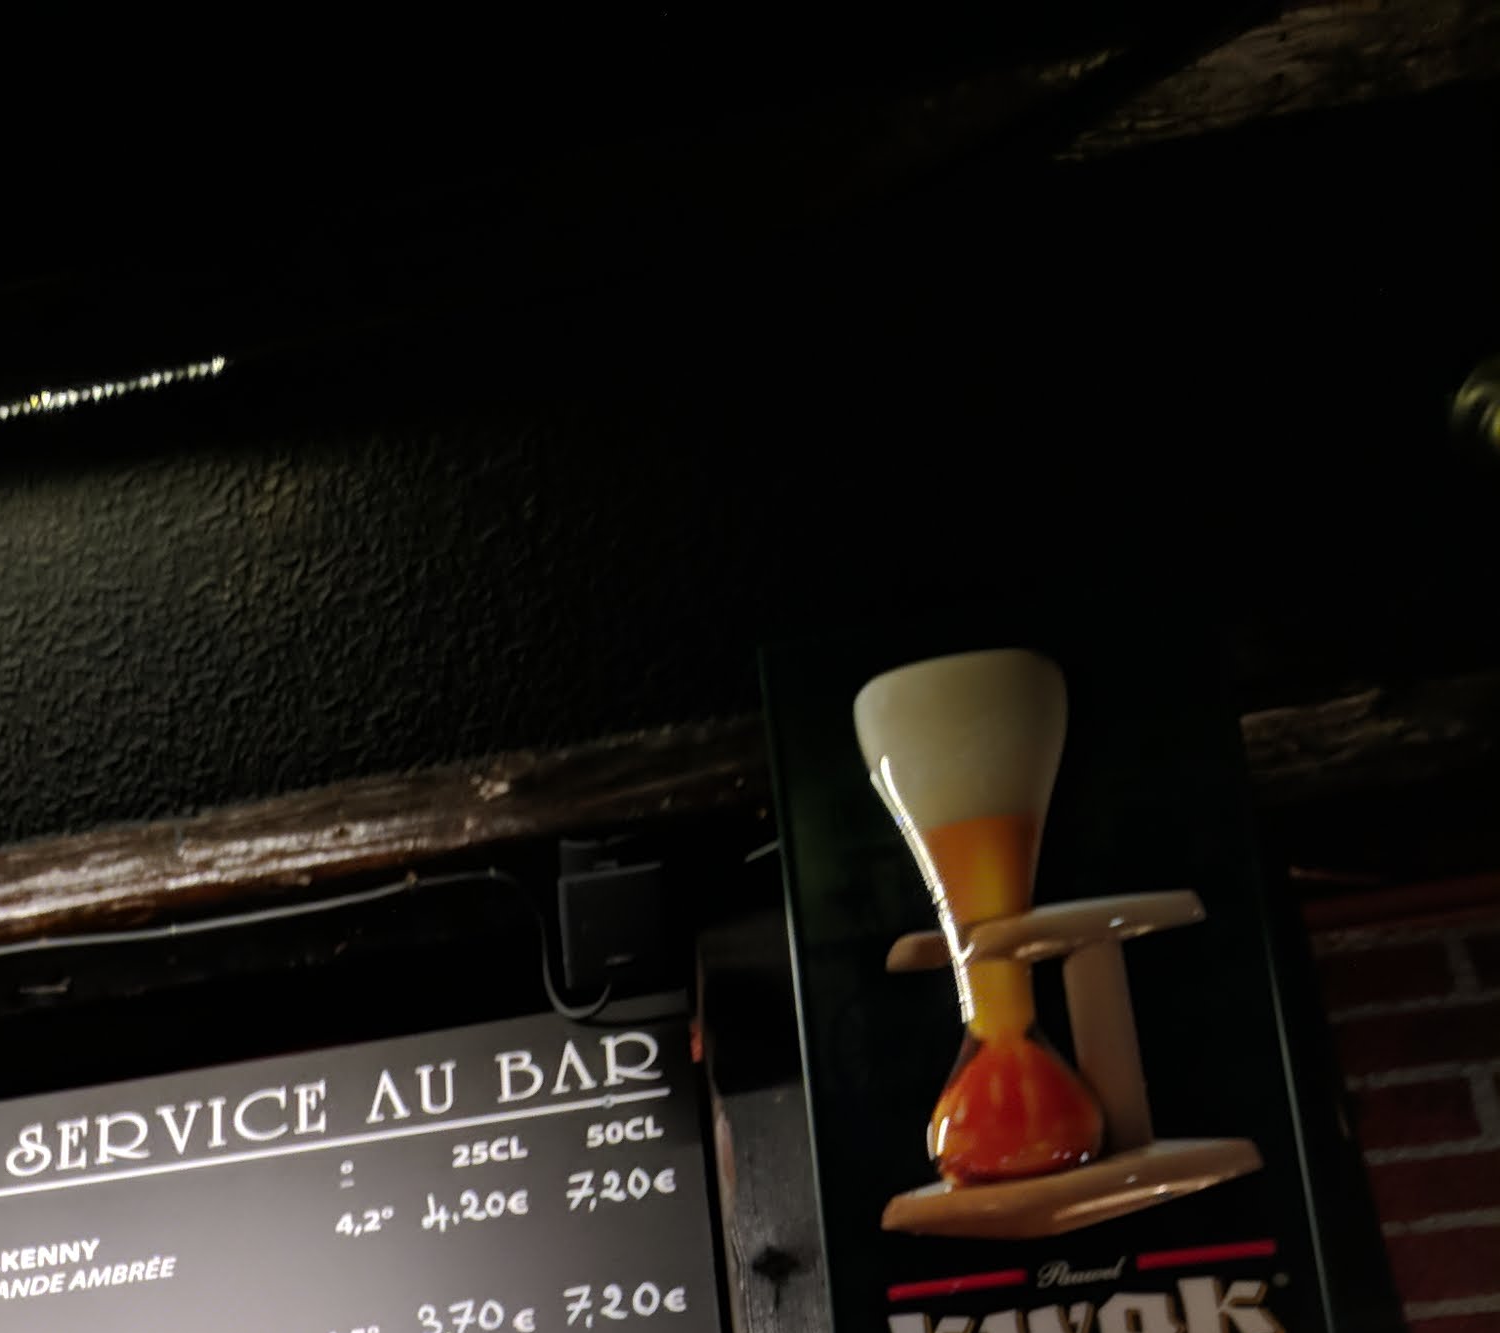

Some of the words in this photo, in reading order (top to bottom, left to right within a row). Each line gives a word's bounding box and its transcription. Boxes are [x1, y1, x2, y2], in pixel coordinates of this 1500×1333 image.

[5, 1078, 327, 1178] SERVICE
[365, 1060, 457, 1125] AU
[494, 1030, 661, 1104] BAR
[451, 1135, 529, 1169] 25CL
[586, 1114, 664, 1149] 50CL
[66, 1254, 178, 1292] AMBRÉE
